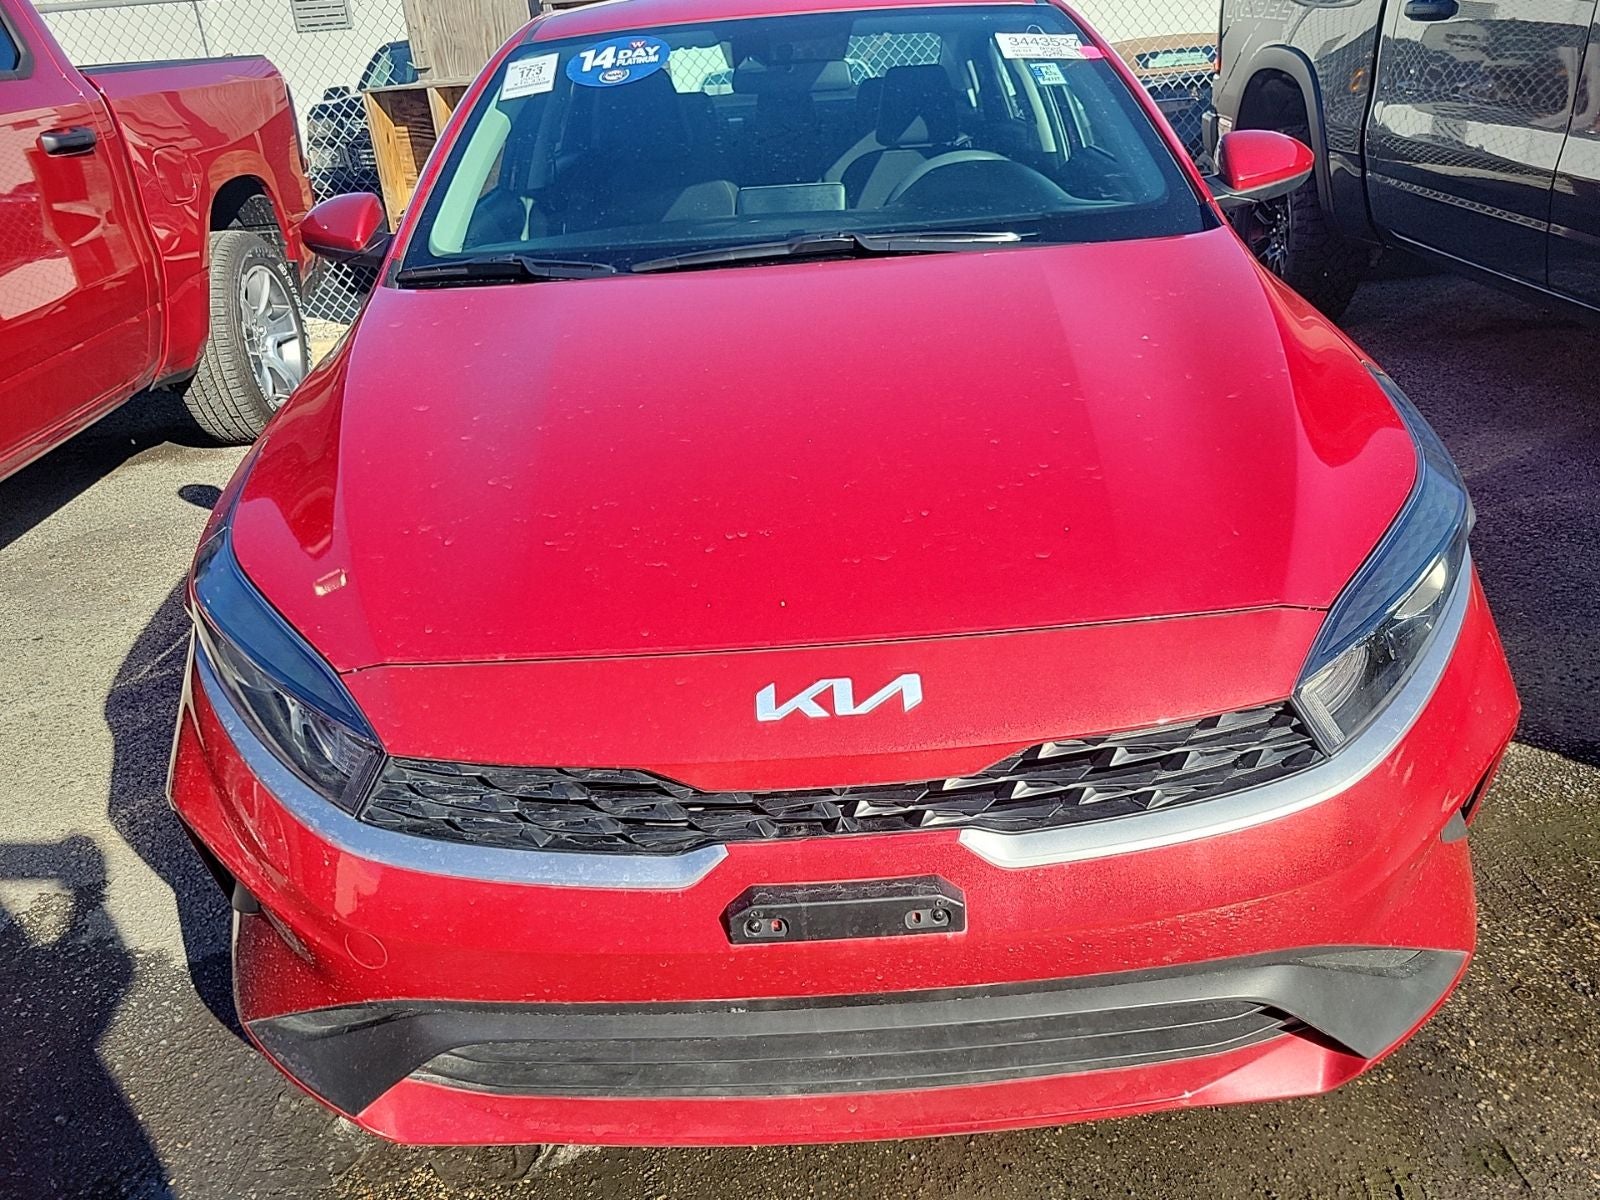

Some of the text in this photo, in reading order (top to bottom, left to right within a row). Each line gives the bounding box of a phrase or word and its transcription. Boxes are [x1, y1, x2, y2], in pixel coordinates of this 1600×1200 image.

[1008, 36, 1078, 47] 3443527
[580, 45, 660, 72] 14 DAY
[616, 55, 659, 67] PLATINUM
[755, 672, 924, 723] KIA
